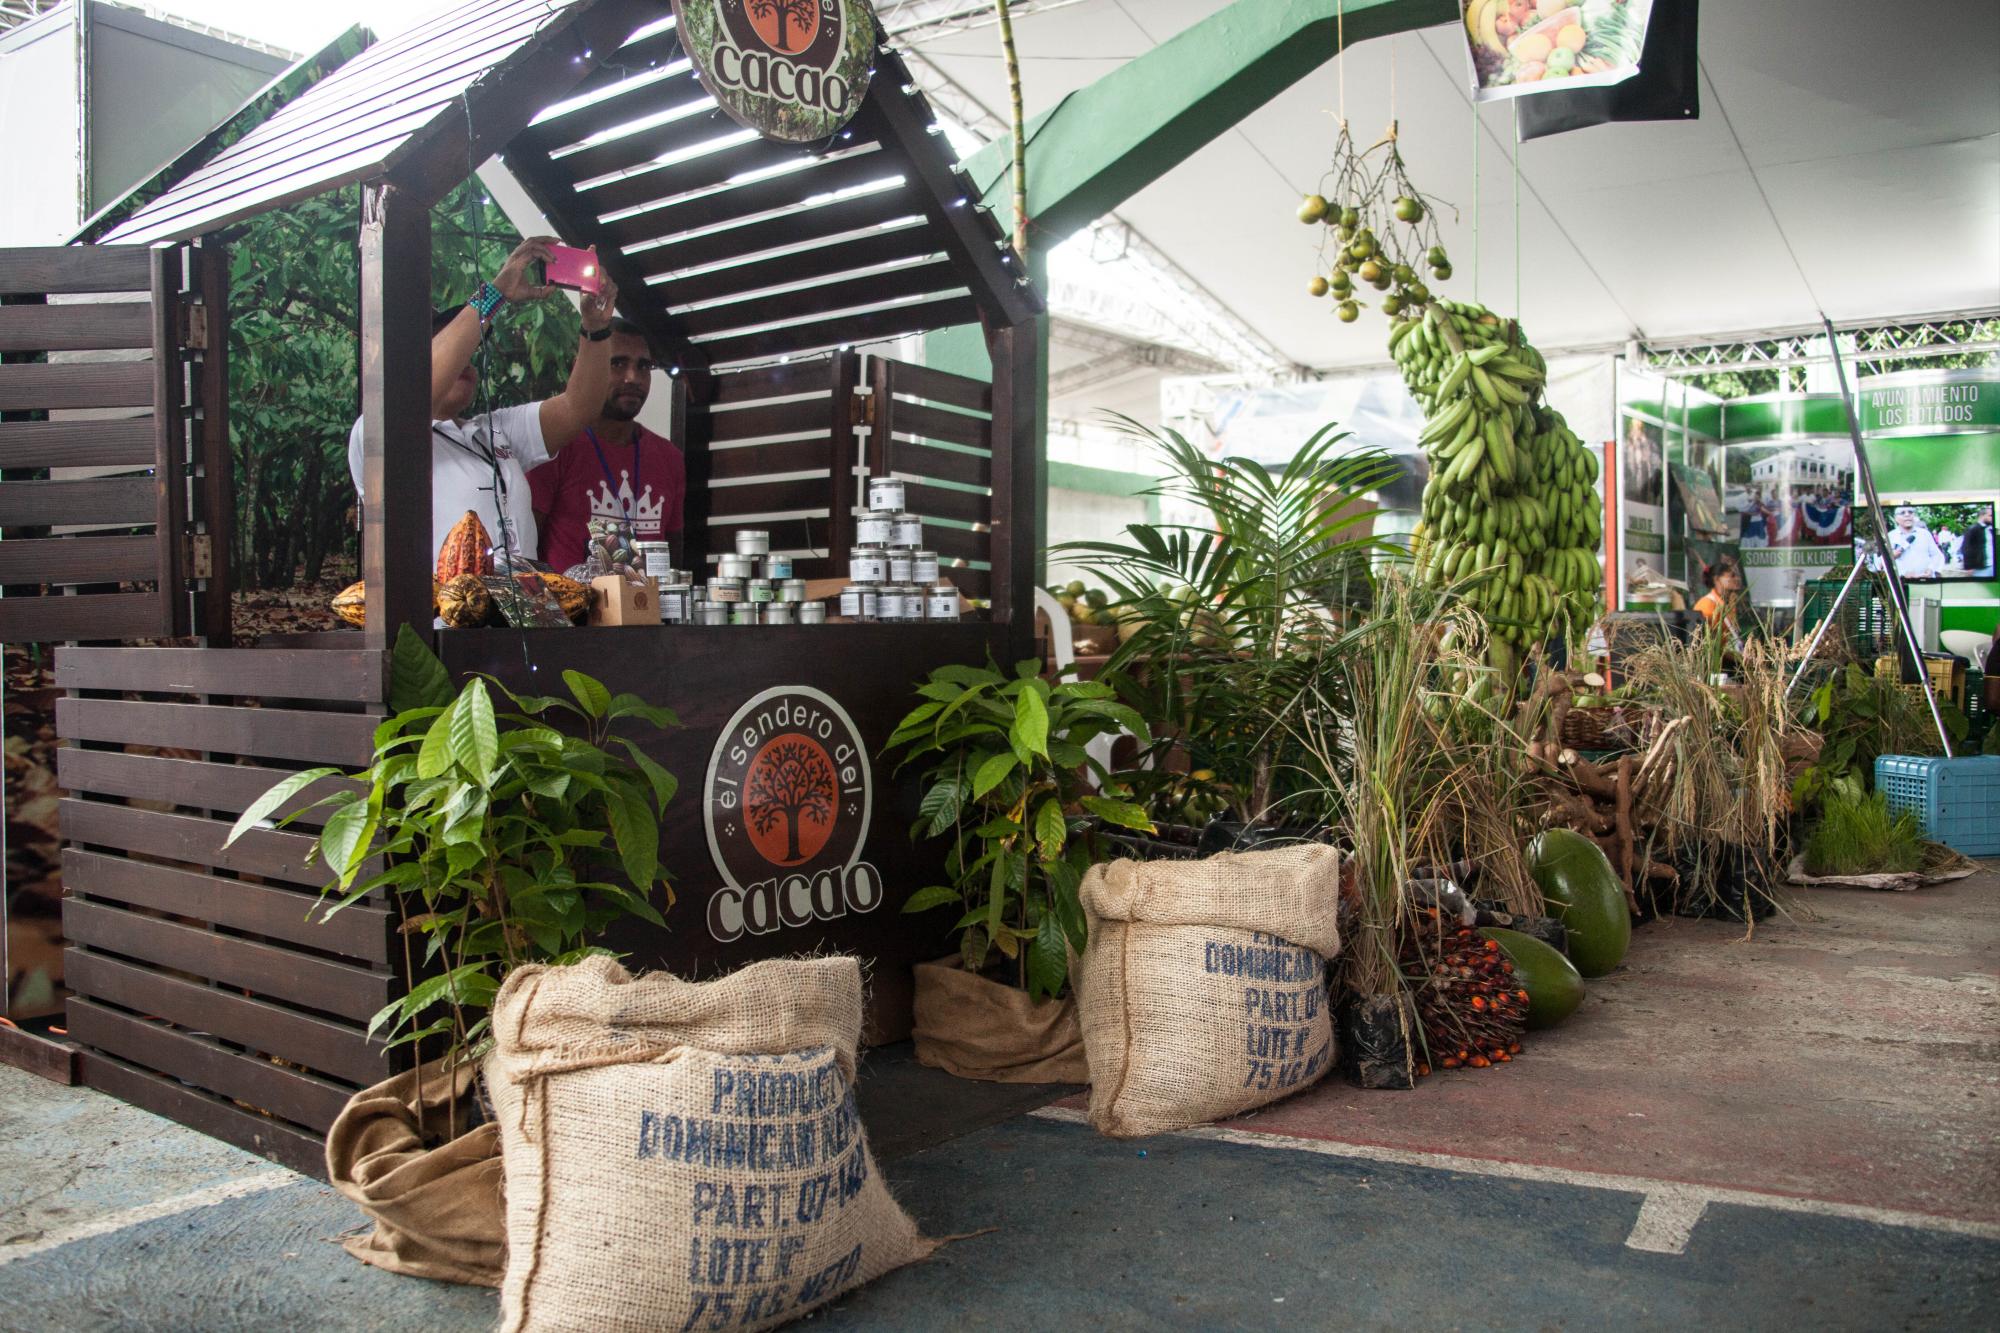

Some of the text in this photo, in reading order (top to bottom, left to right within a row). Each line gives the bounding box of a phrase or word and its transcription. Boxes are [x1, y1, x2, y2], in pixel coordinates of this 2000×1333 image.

[713, 43, 850, 116] cacao
[1871, 385, 1979, 408] AYUNTAMIENTO
[1879, 404, 1973, 426] LOS BOTADOS
[1745, 550, 1839, 566] SOMOS FOLKLORE
[718, 699, 862, 809] el sendero del
[707, 862, 883, 943] cacao
[1247, 1023, 1292, 1059] LOTE
[1244, 1059, 1283, 1090] 75
[639, 1109, 816, 1170] DOMINICAN
[688, 1236, 771, 1285] LOTE
[680, 1291, 736, 1333] 75
